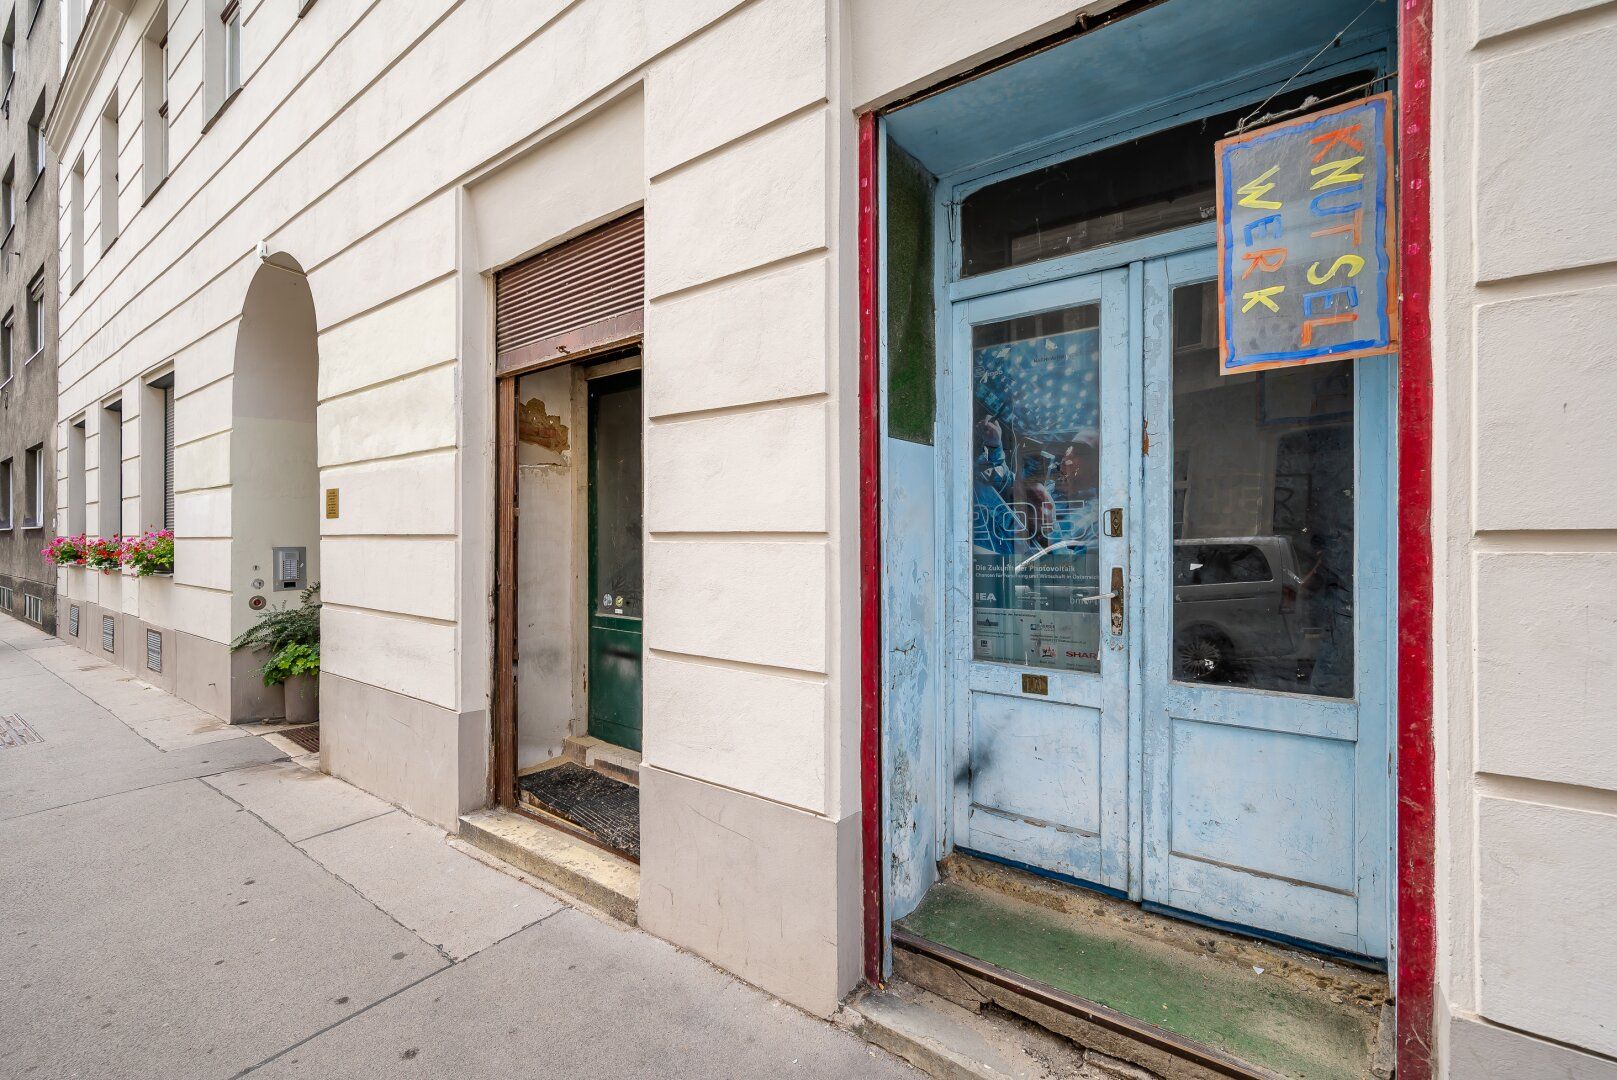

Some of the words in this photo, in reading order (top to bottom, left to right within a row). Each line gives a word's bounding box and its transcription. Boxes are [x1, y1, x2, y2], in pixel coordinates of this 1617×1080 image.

[1236, 164, 1288, 314] WERK
[1301, 123, 1366, 347] KNUTSEL
[975, 592, 997, 601] IEA
[1065, 650, 1098, 659] SHAR
